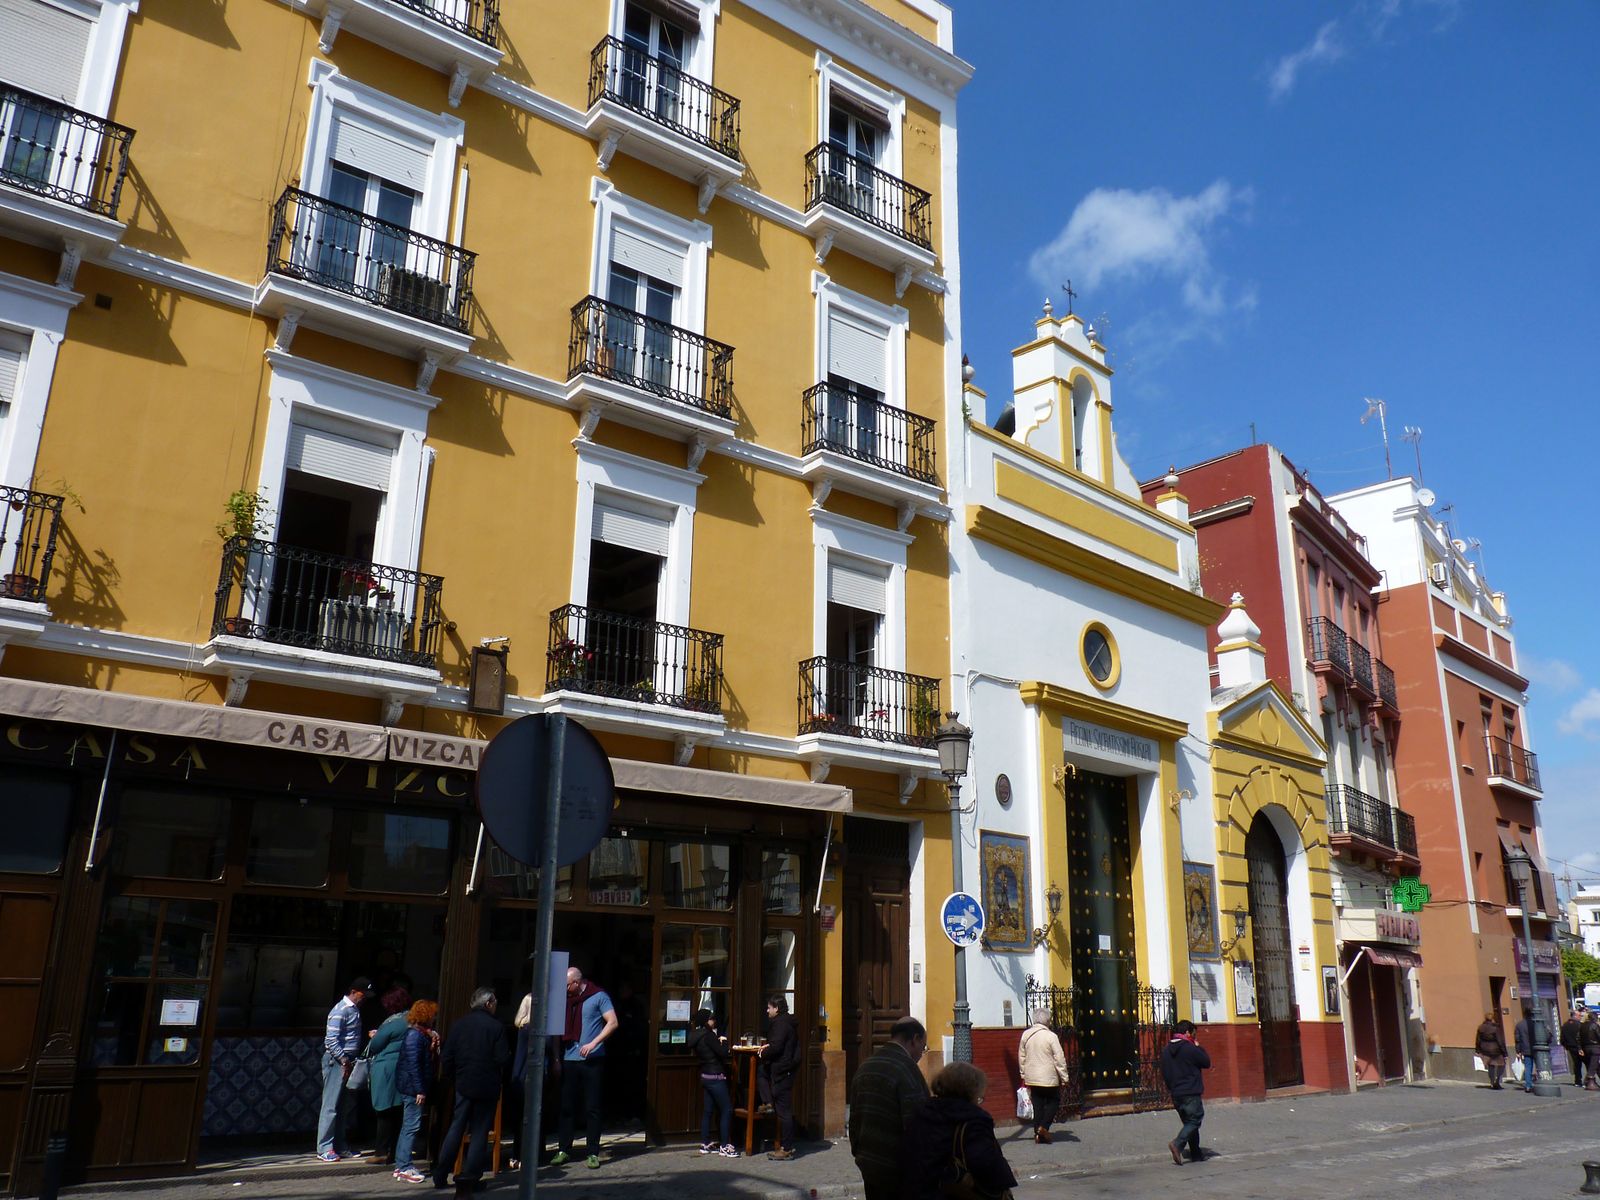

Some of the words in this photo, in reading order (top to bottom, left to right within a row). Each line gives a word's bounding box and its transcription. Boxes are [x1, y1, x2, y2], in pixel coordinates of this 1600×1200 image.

[6, 721, 208, 771] CASA
[318, 756, 469, 798] VIZC
[267, 720, 351, 754] CASA
